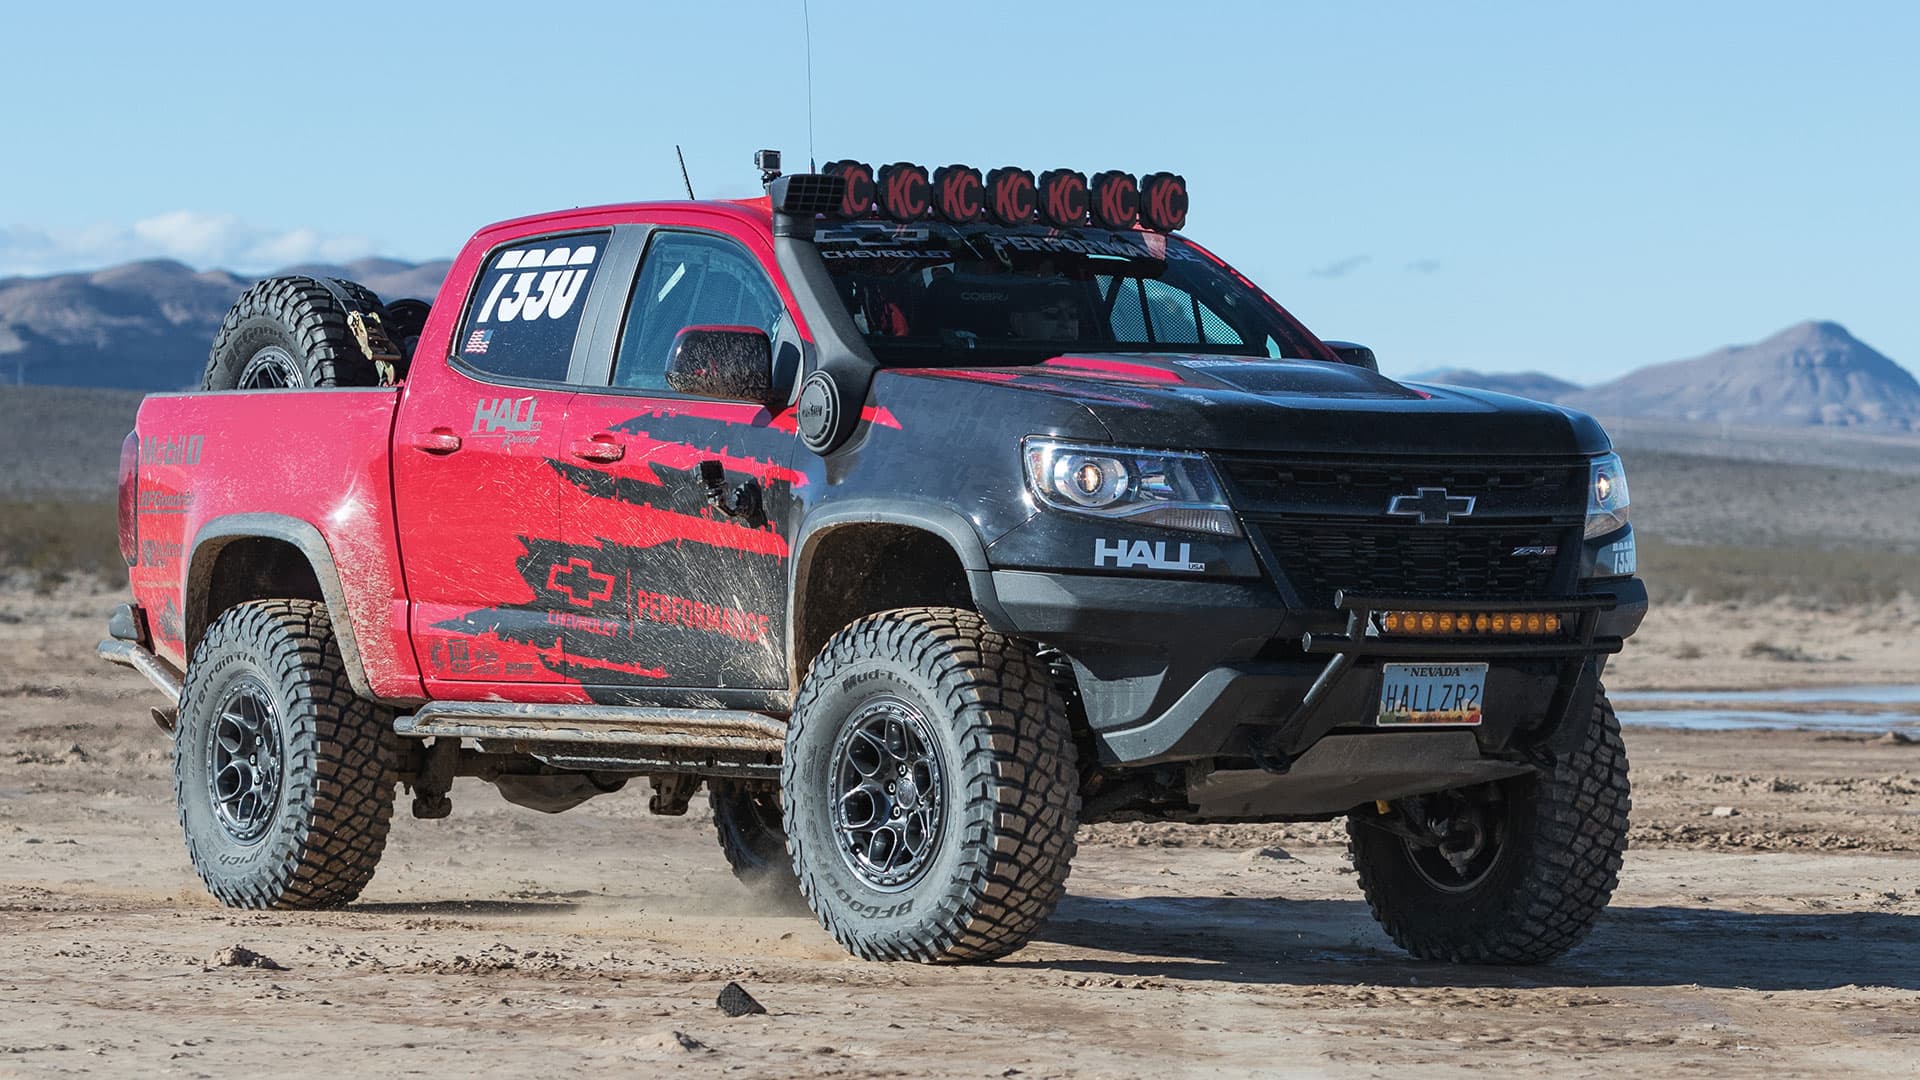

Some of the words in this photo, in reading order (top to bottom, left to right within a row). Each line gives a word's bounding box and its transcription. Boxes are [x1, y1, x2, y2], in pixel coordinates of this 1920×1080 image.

[888, 169, 924, 218] KC
[943, 171, 978, 220] KC
[996, 173, 1031, 221] KC
[1049, 175, 1083, 223] KC
[1102, 177, 1135, 224] KC
[1151, 179, 1183, 226] KC
[821, 250, 952, 259] CHEVROLET
[986, 234, 1201, 262] PERFORMANCE
[472, 398, 537, 432] HALL
[141, 436, 187, 466] Mobil
[1094, 538, 1191, 571] HALL
[547, 610, 619, 638] CHEVROLET
[636, 590, 769, 644] PERFORMANCE
[1410, 667, 1461, 677] NEVADA
[1385, 683, 1480, 713] HALLZR2
